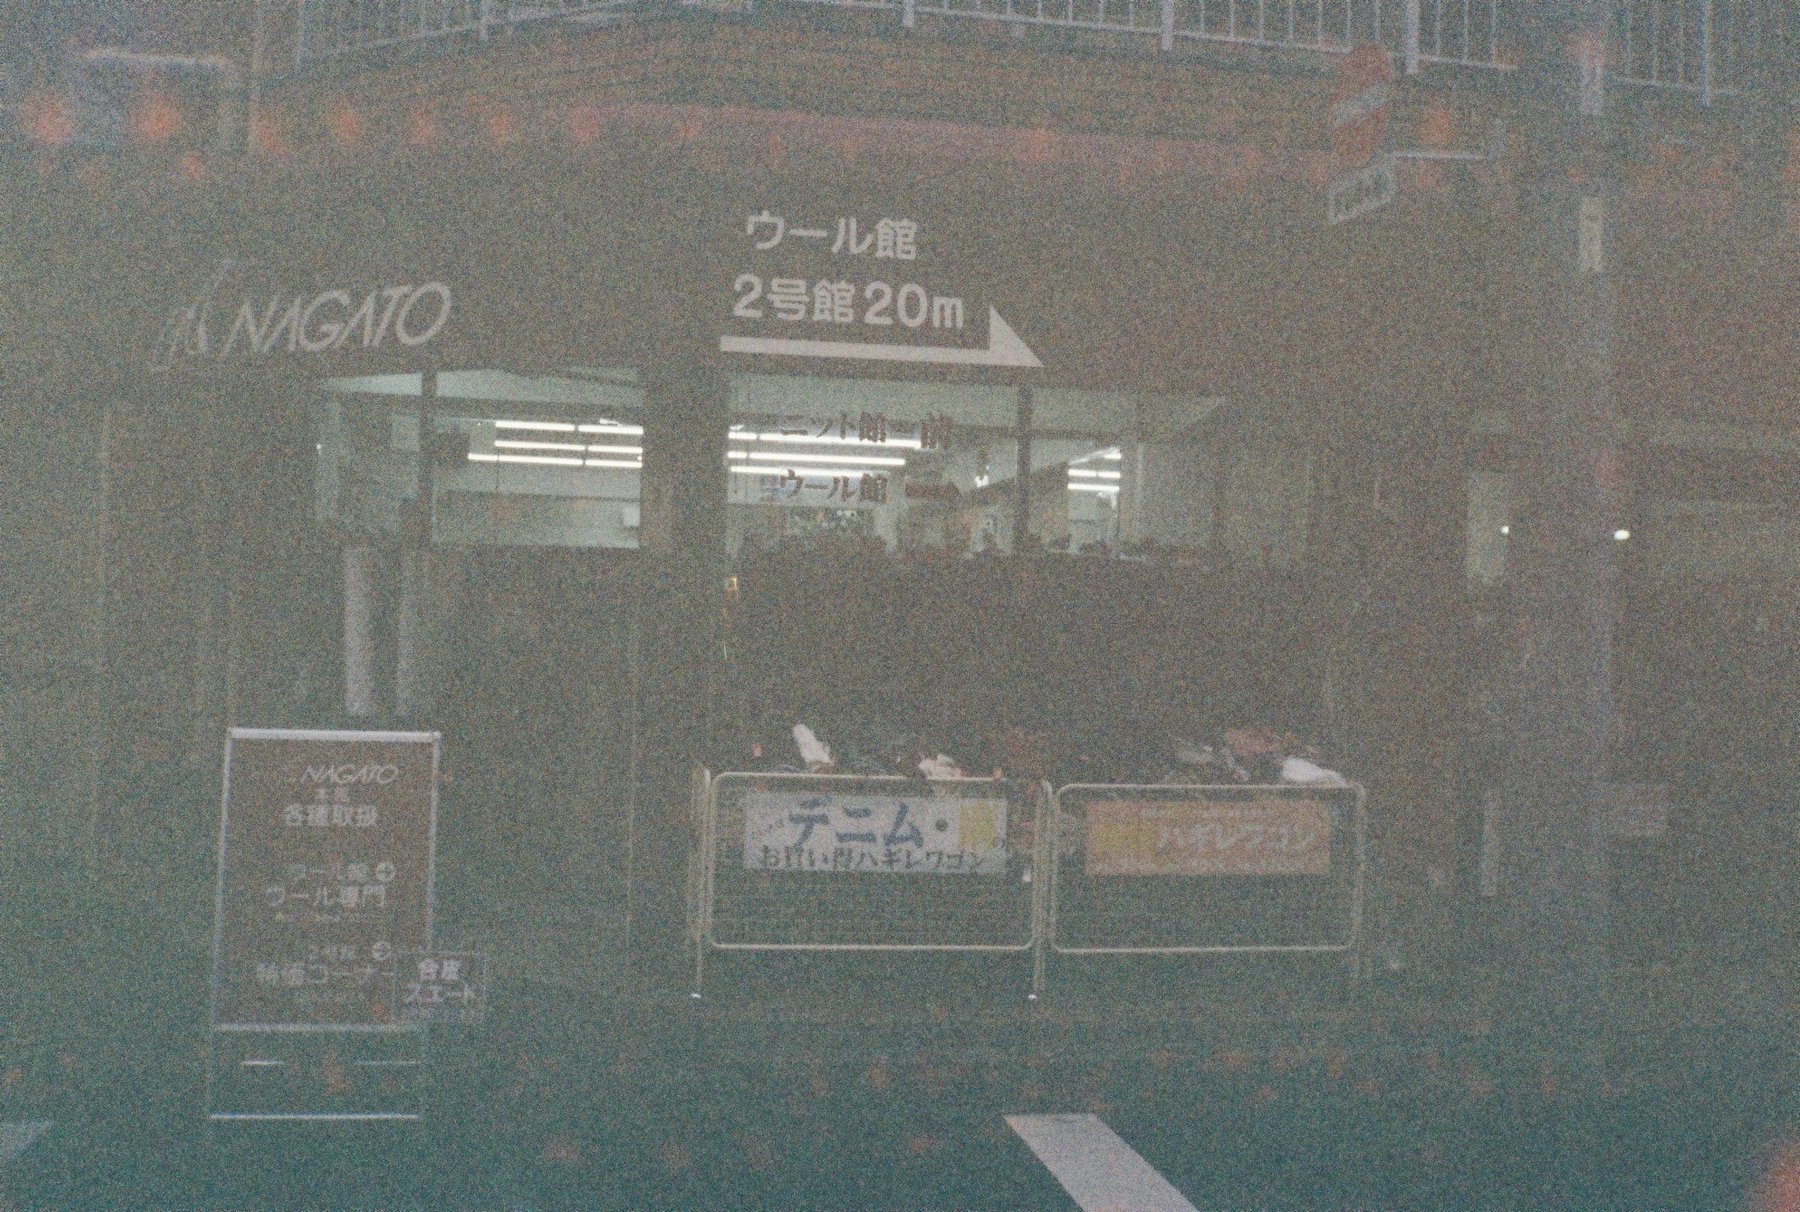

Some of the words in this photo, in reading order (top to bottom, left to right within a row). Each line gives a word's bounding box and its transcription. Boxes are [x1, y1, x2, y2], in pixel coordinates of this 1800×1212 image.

[747, 210, 918, 260] ウール館
[219, 281, 451, 361] NAGATO
[779, 469, 888, 503] ウール館
[299, 763, 399, 785] NAGATO
